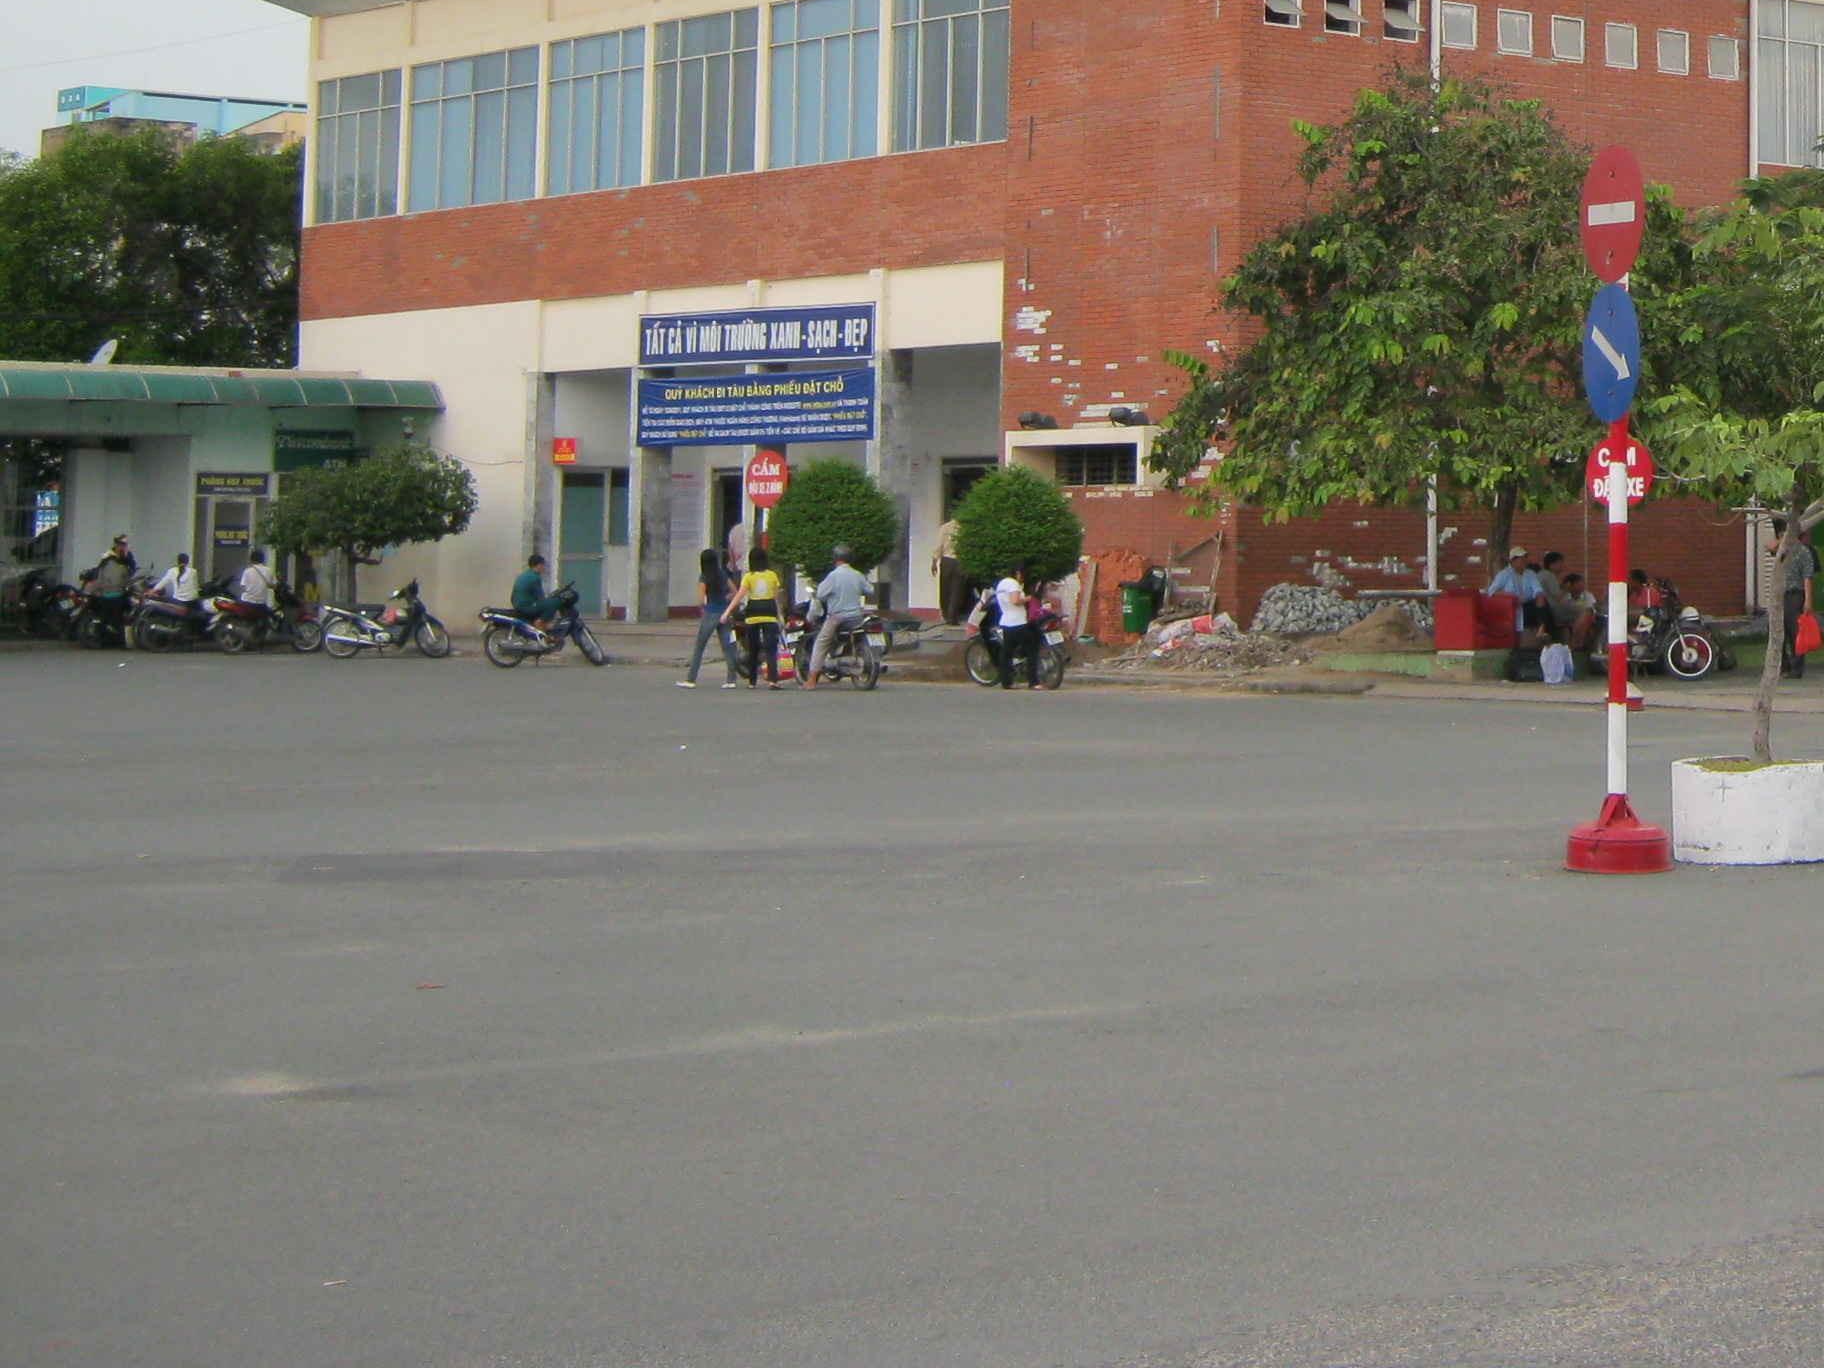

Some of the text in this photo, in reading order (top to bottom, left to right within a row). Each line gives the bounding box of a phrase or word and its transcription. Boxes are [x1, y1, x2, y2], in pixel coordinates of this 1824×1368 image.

[645, 321, 666, 356] TẤT
[667, 320, 682, 354] CẢ
[686, 322, 698, 353] VÌ
[699, 320, 722, 352] MÔI
[725, 318, 767, 352] TRƯỜNG
[685, 384, 715, 400] KHÁCH
[716, 387, 726, 398] ĐI
[728, 383, 744, 398] TÀU
[324, 459, 348, 469] AT
[752, 457, 780, 476] CẤM
[1598, 447, 1636, 467] CM
[1627, 477, 1644, 496] XE
